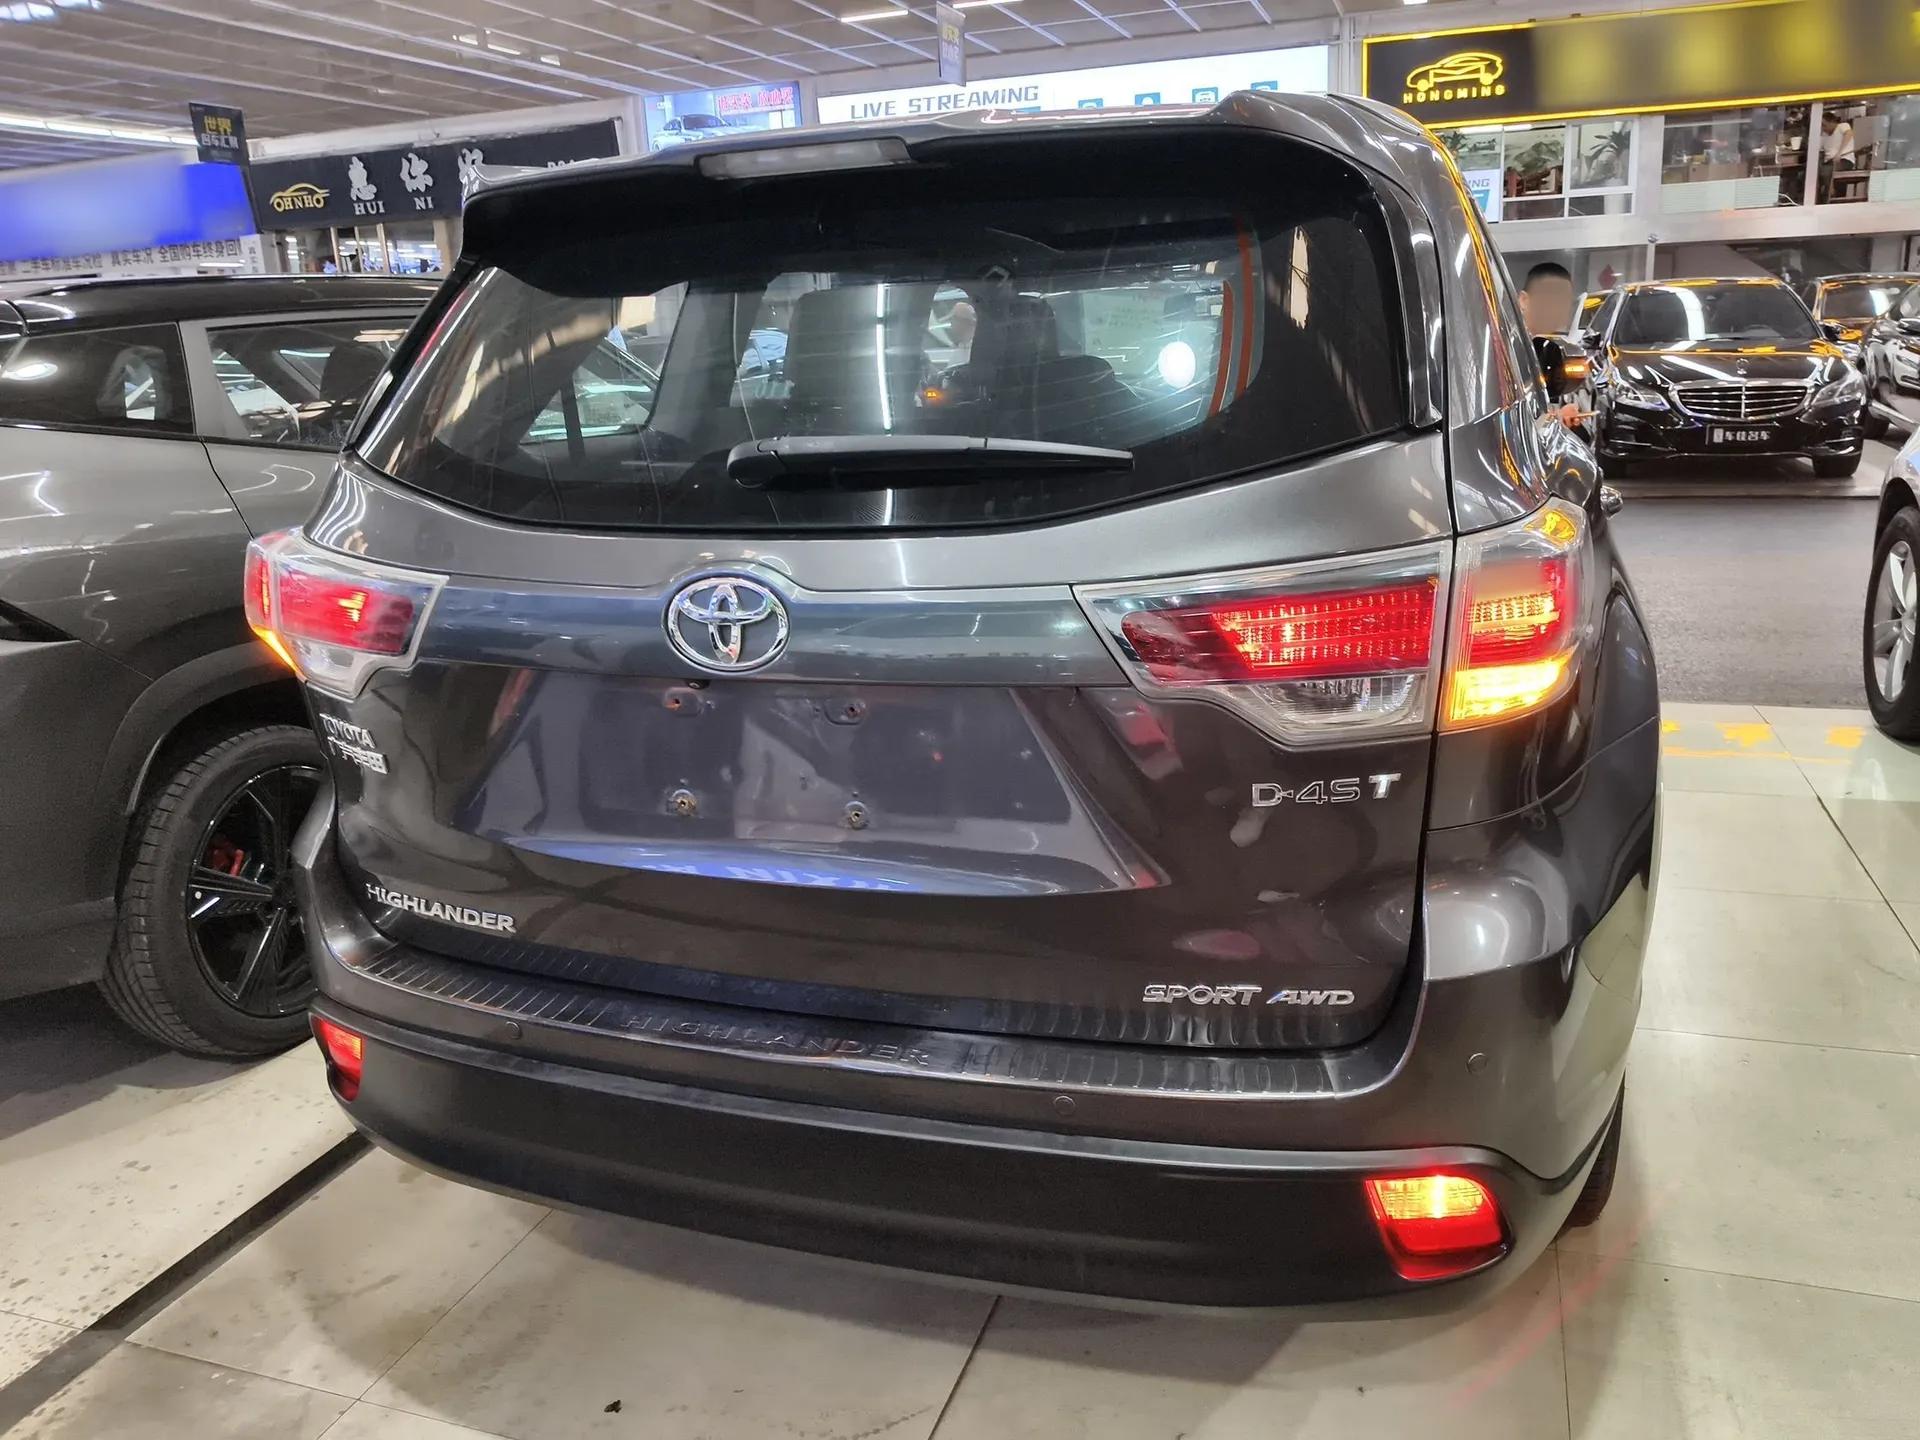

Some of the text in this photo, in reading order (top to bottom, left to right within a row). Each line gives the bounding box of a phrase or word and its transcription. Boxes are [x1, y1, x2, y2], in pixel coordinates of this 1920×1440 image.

[1403, 84, 1505, 104] HONGMING
[851, 100, 897, 119] LIVE
[204, 115, 232, 135] 世界
[273, 193, 326, 213] OHNHO
[353, 195, 434, 216] HUI NI
[319, 713, 375, 749] TOYOTA
[366, 883, 516, 933] HIGHLANDER
[1142, 984, 1355, 1005] SPORT AWD
[621, 1013, 931, 1066] HIGHLANDER
